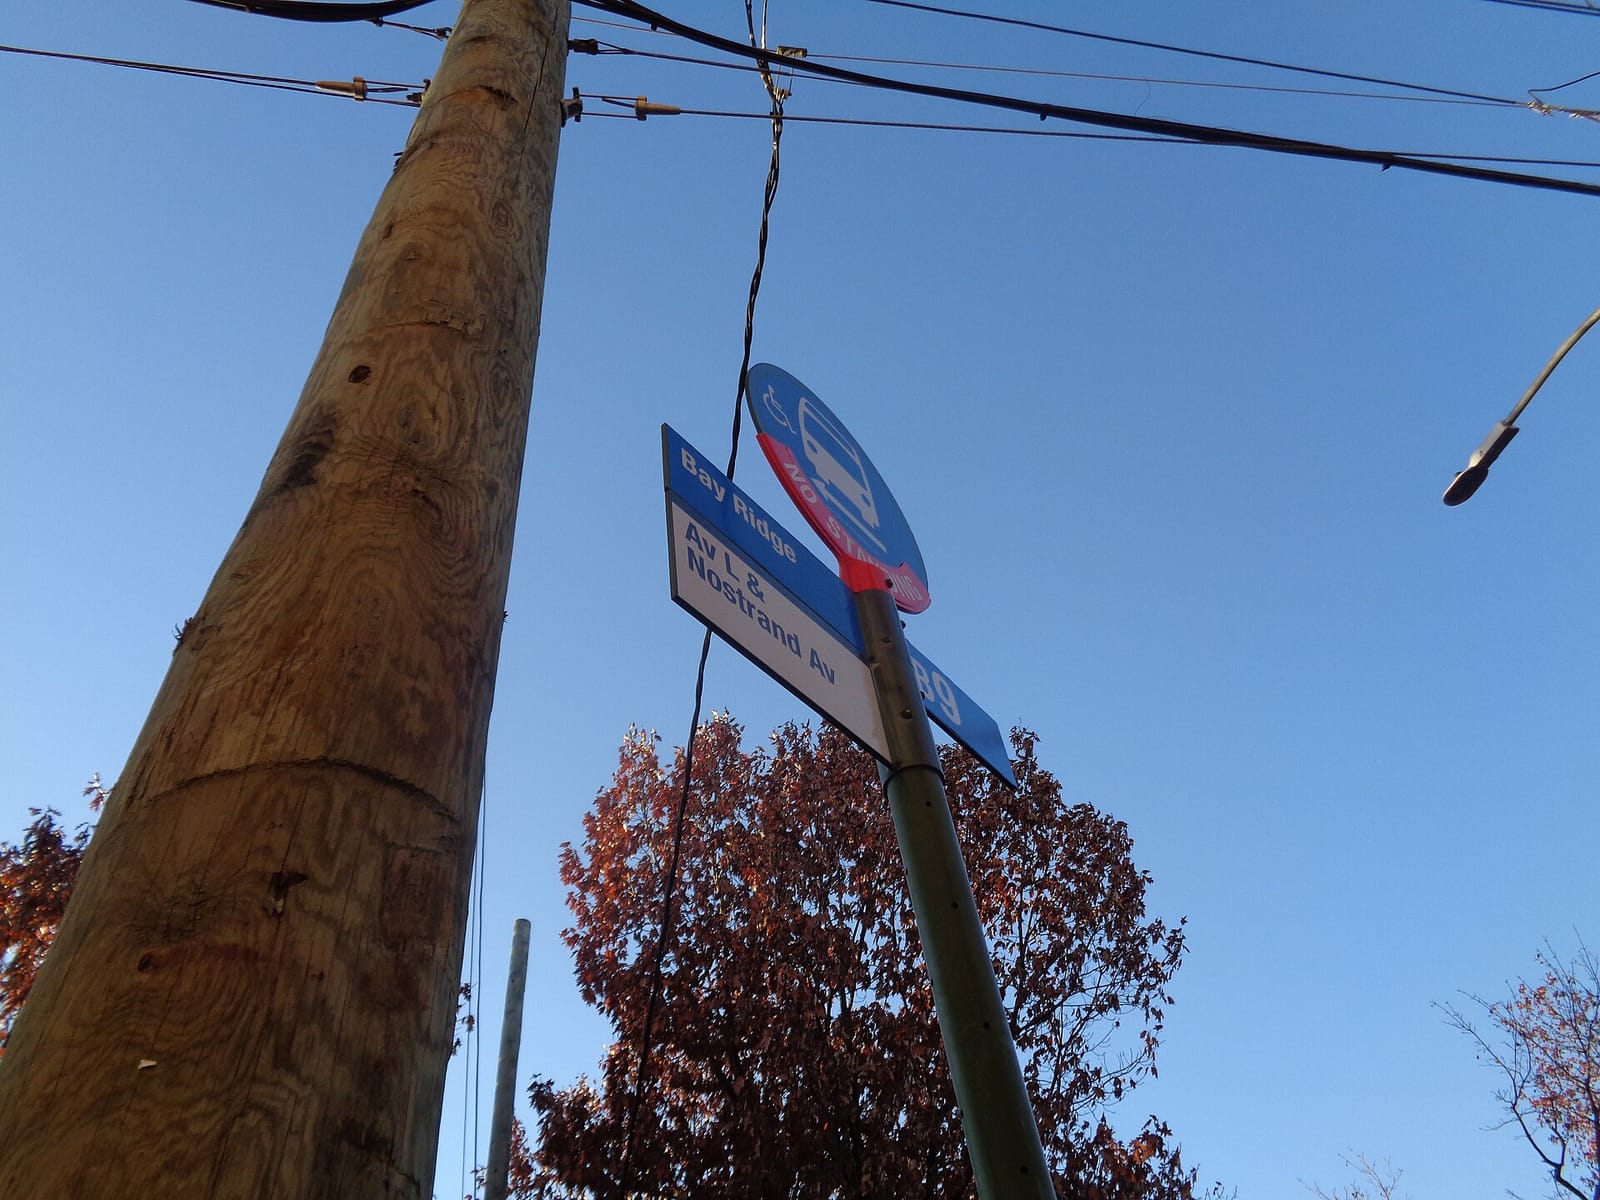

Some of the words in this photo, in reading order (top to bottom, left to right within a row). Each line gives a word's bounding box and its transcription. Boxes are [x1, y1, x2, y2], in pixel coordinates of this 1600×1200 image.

[681, 447, 725, 501] Bay
[732, 492, 797, 564] Ridge
[684, 521, 717, 561] Av
[724, 553, 740, 582] L
[746, 572, 766, 603] &
[784, 462, 818, 503] NO
[826, 515, 922, 600] STADING
[687, 545, 802, 659] Nostrand
[809, 647, 836, 685] Av
[910, 655, 961, 726] B9
